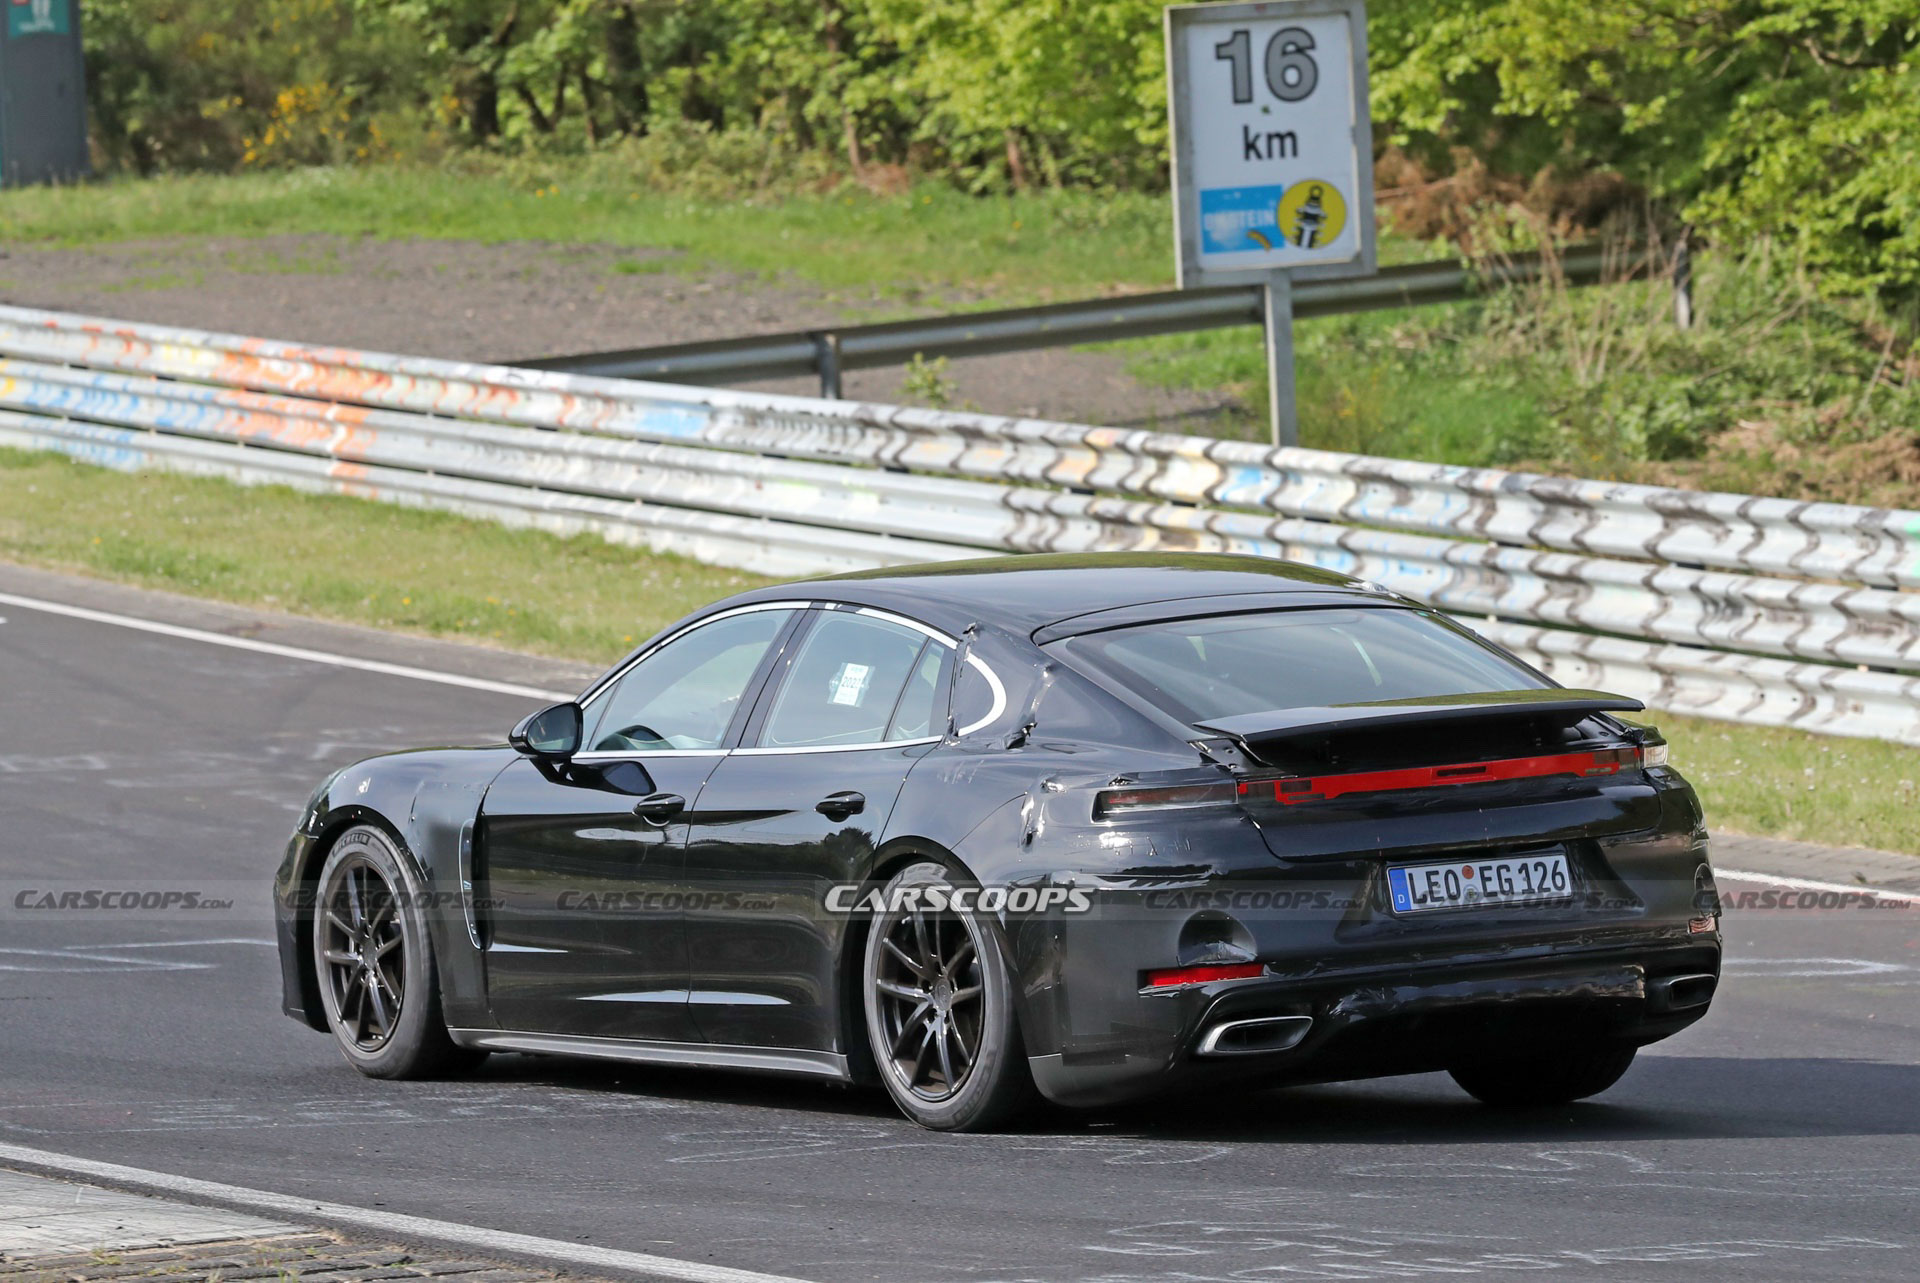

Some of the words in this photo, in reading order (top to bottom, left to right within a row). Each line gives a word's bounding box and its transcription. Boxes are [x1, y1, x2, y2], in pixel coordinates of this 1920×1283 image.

[1215, 27, 1319, 104] 16
[1243, 125, 1298, 161] km
[1408, 869, 1461, 904] LEO
[1479, 865, 1514, 898] EG
[1518, 860, 1566, 894] 126
